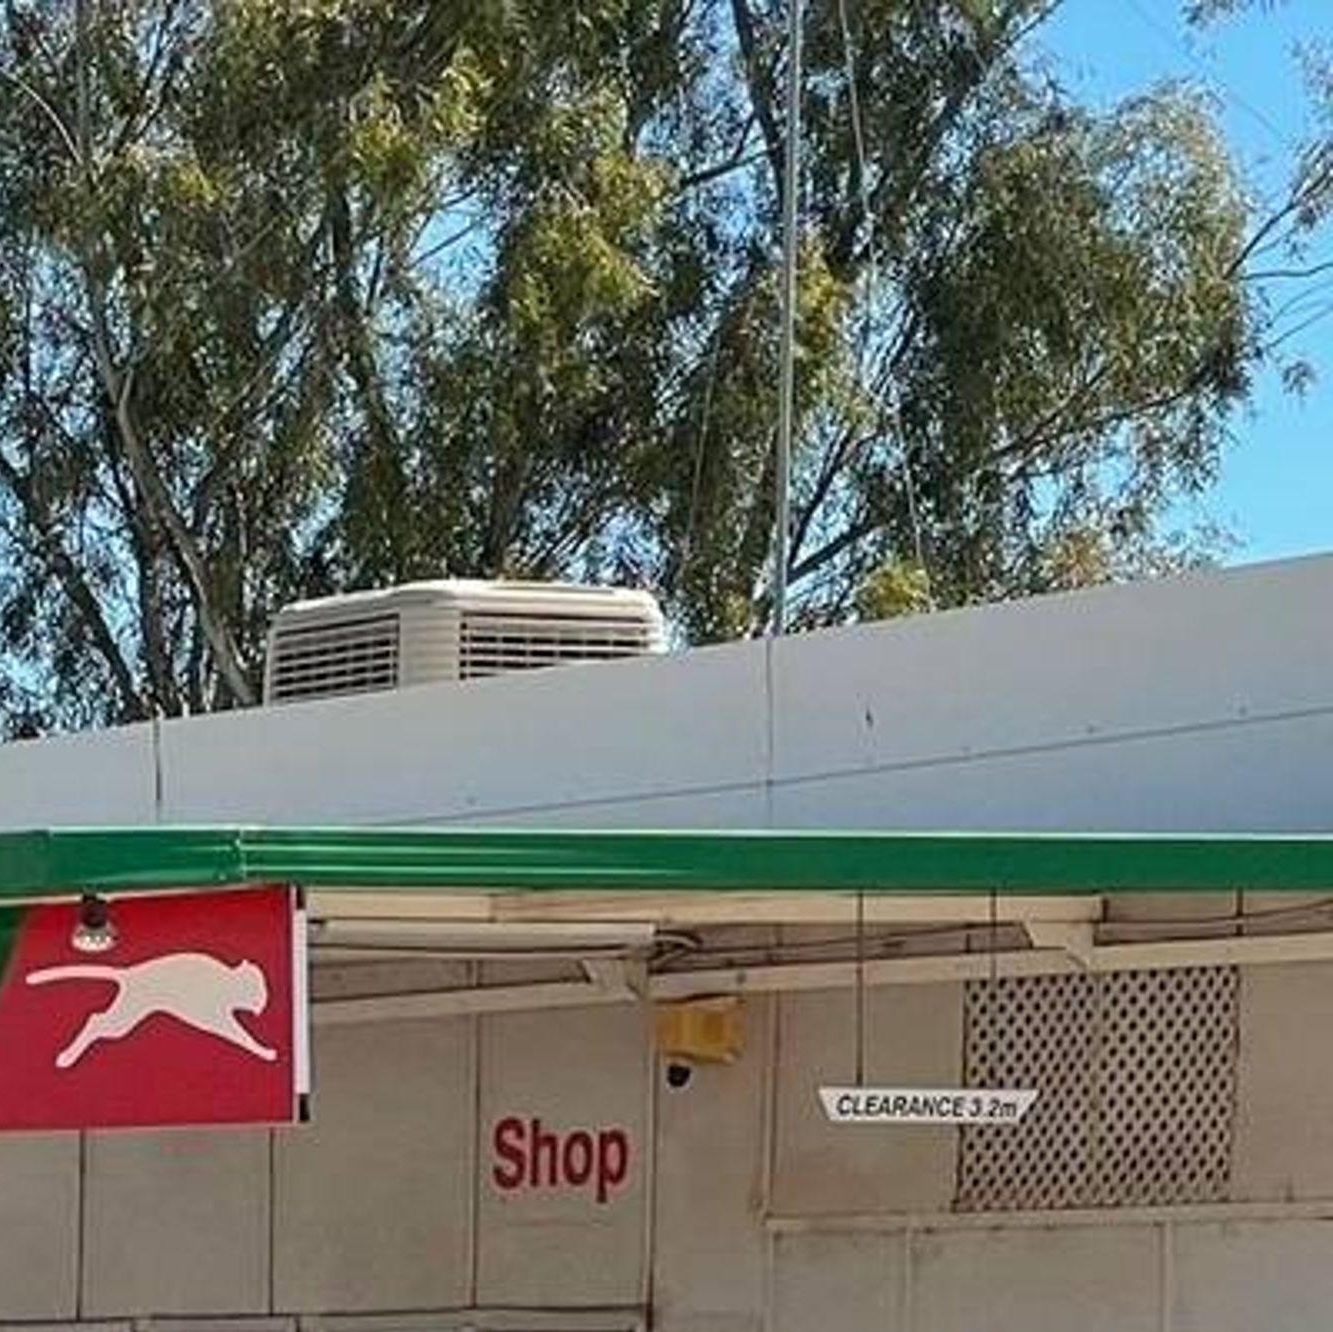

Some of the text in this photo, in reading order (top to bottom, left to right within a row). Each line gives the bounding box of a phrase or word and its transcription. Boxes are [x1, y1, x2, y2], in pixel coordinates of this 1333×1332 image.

[836, 1095, 1017, 1118] CLEARANCE 3.2m
[493, 1117, 628, 1203] Shop
